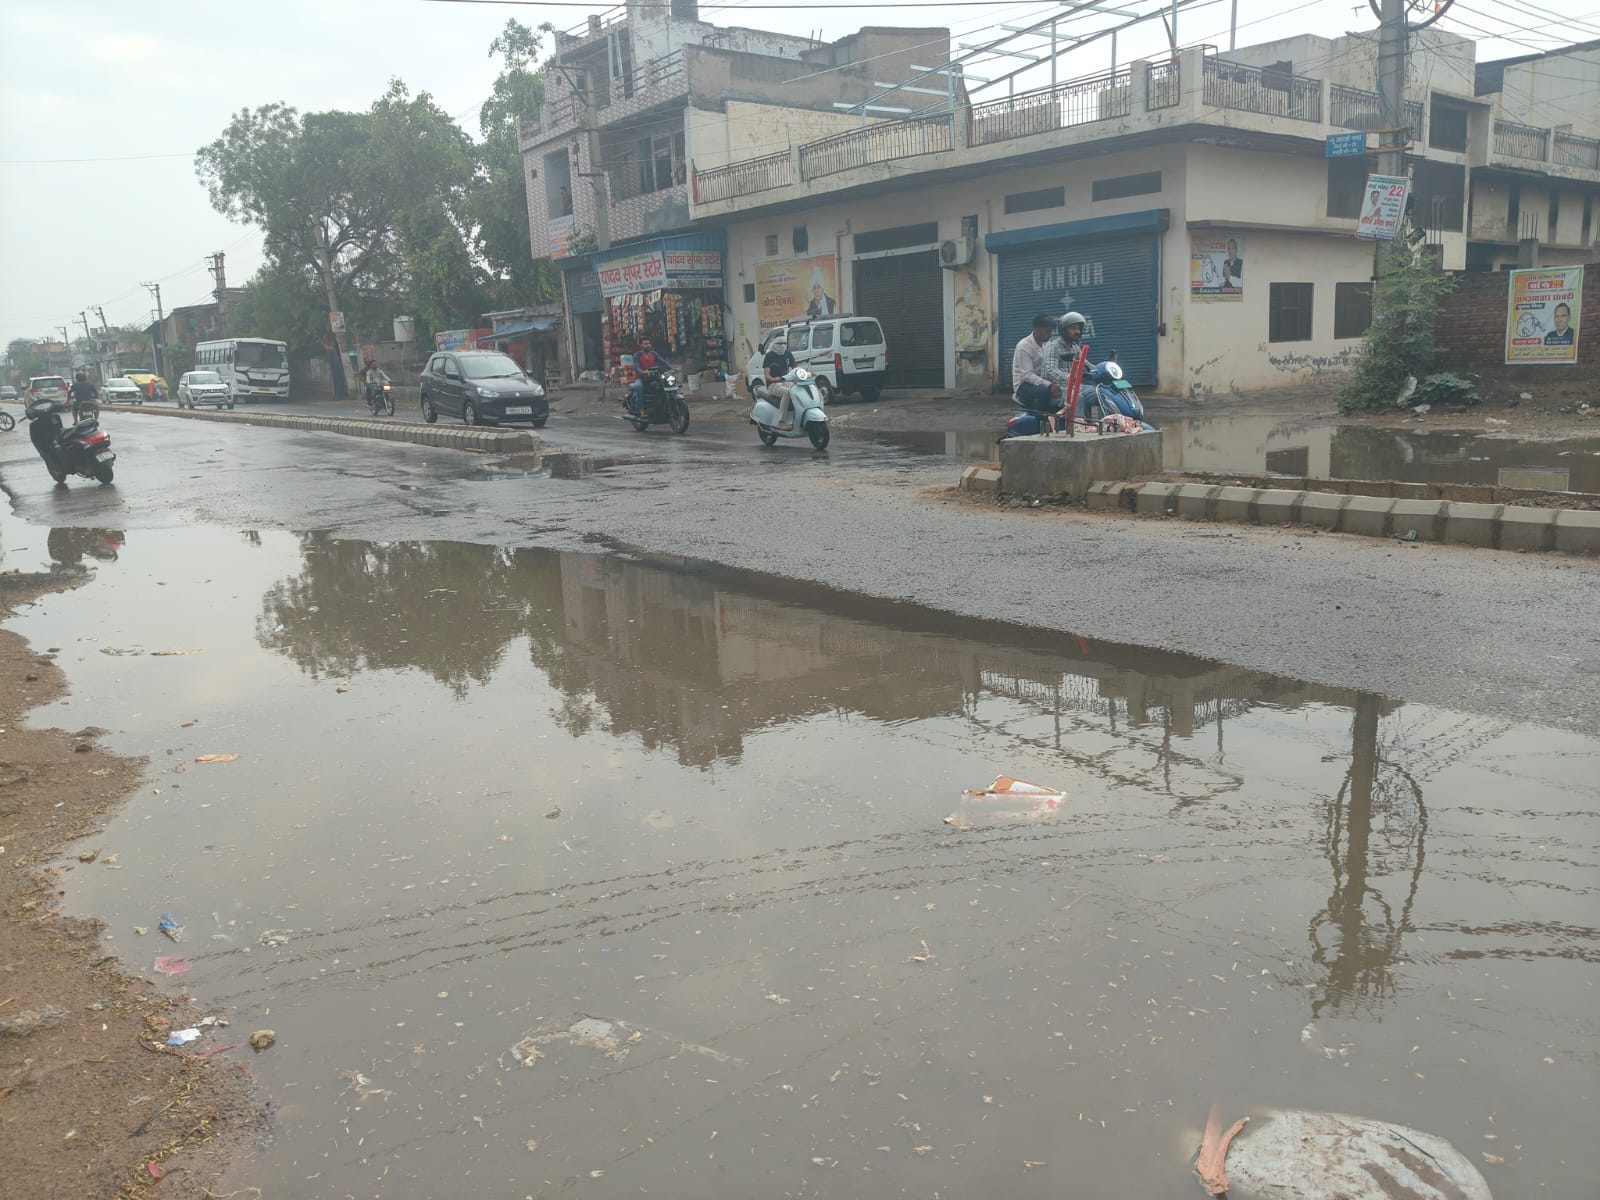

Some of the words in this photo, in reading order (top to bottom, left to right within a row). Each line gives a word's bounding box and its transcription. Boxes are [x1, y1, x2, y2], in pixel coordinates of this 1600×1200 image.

[1389, 185, 1404, 197] 22
[600, 267, 621, 286] यादव
[622, 263, 642, 290] सुपर
[643, 254, 663, 278] स्टोर
[666, 254, 685, 265] यादव
[687, 254, 703, 268] सुपर
[704, 254, 720, 265] स्टोर
[1032, 262, 1104, 292] BANGUR
